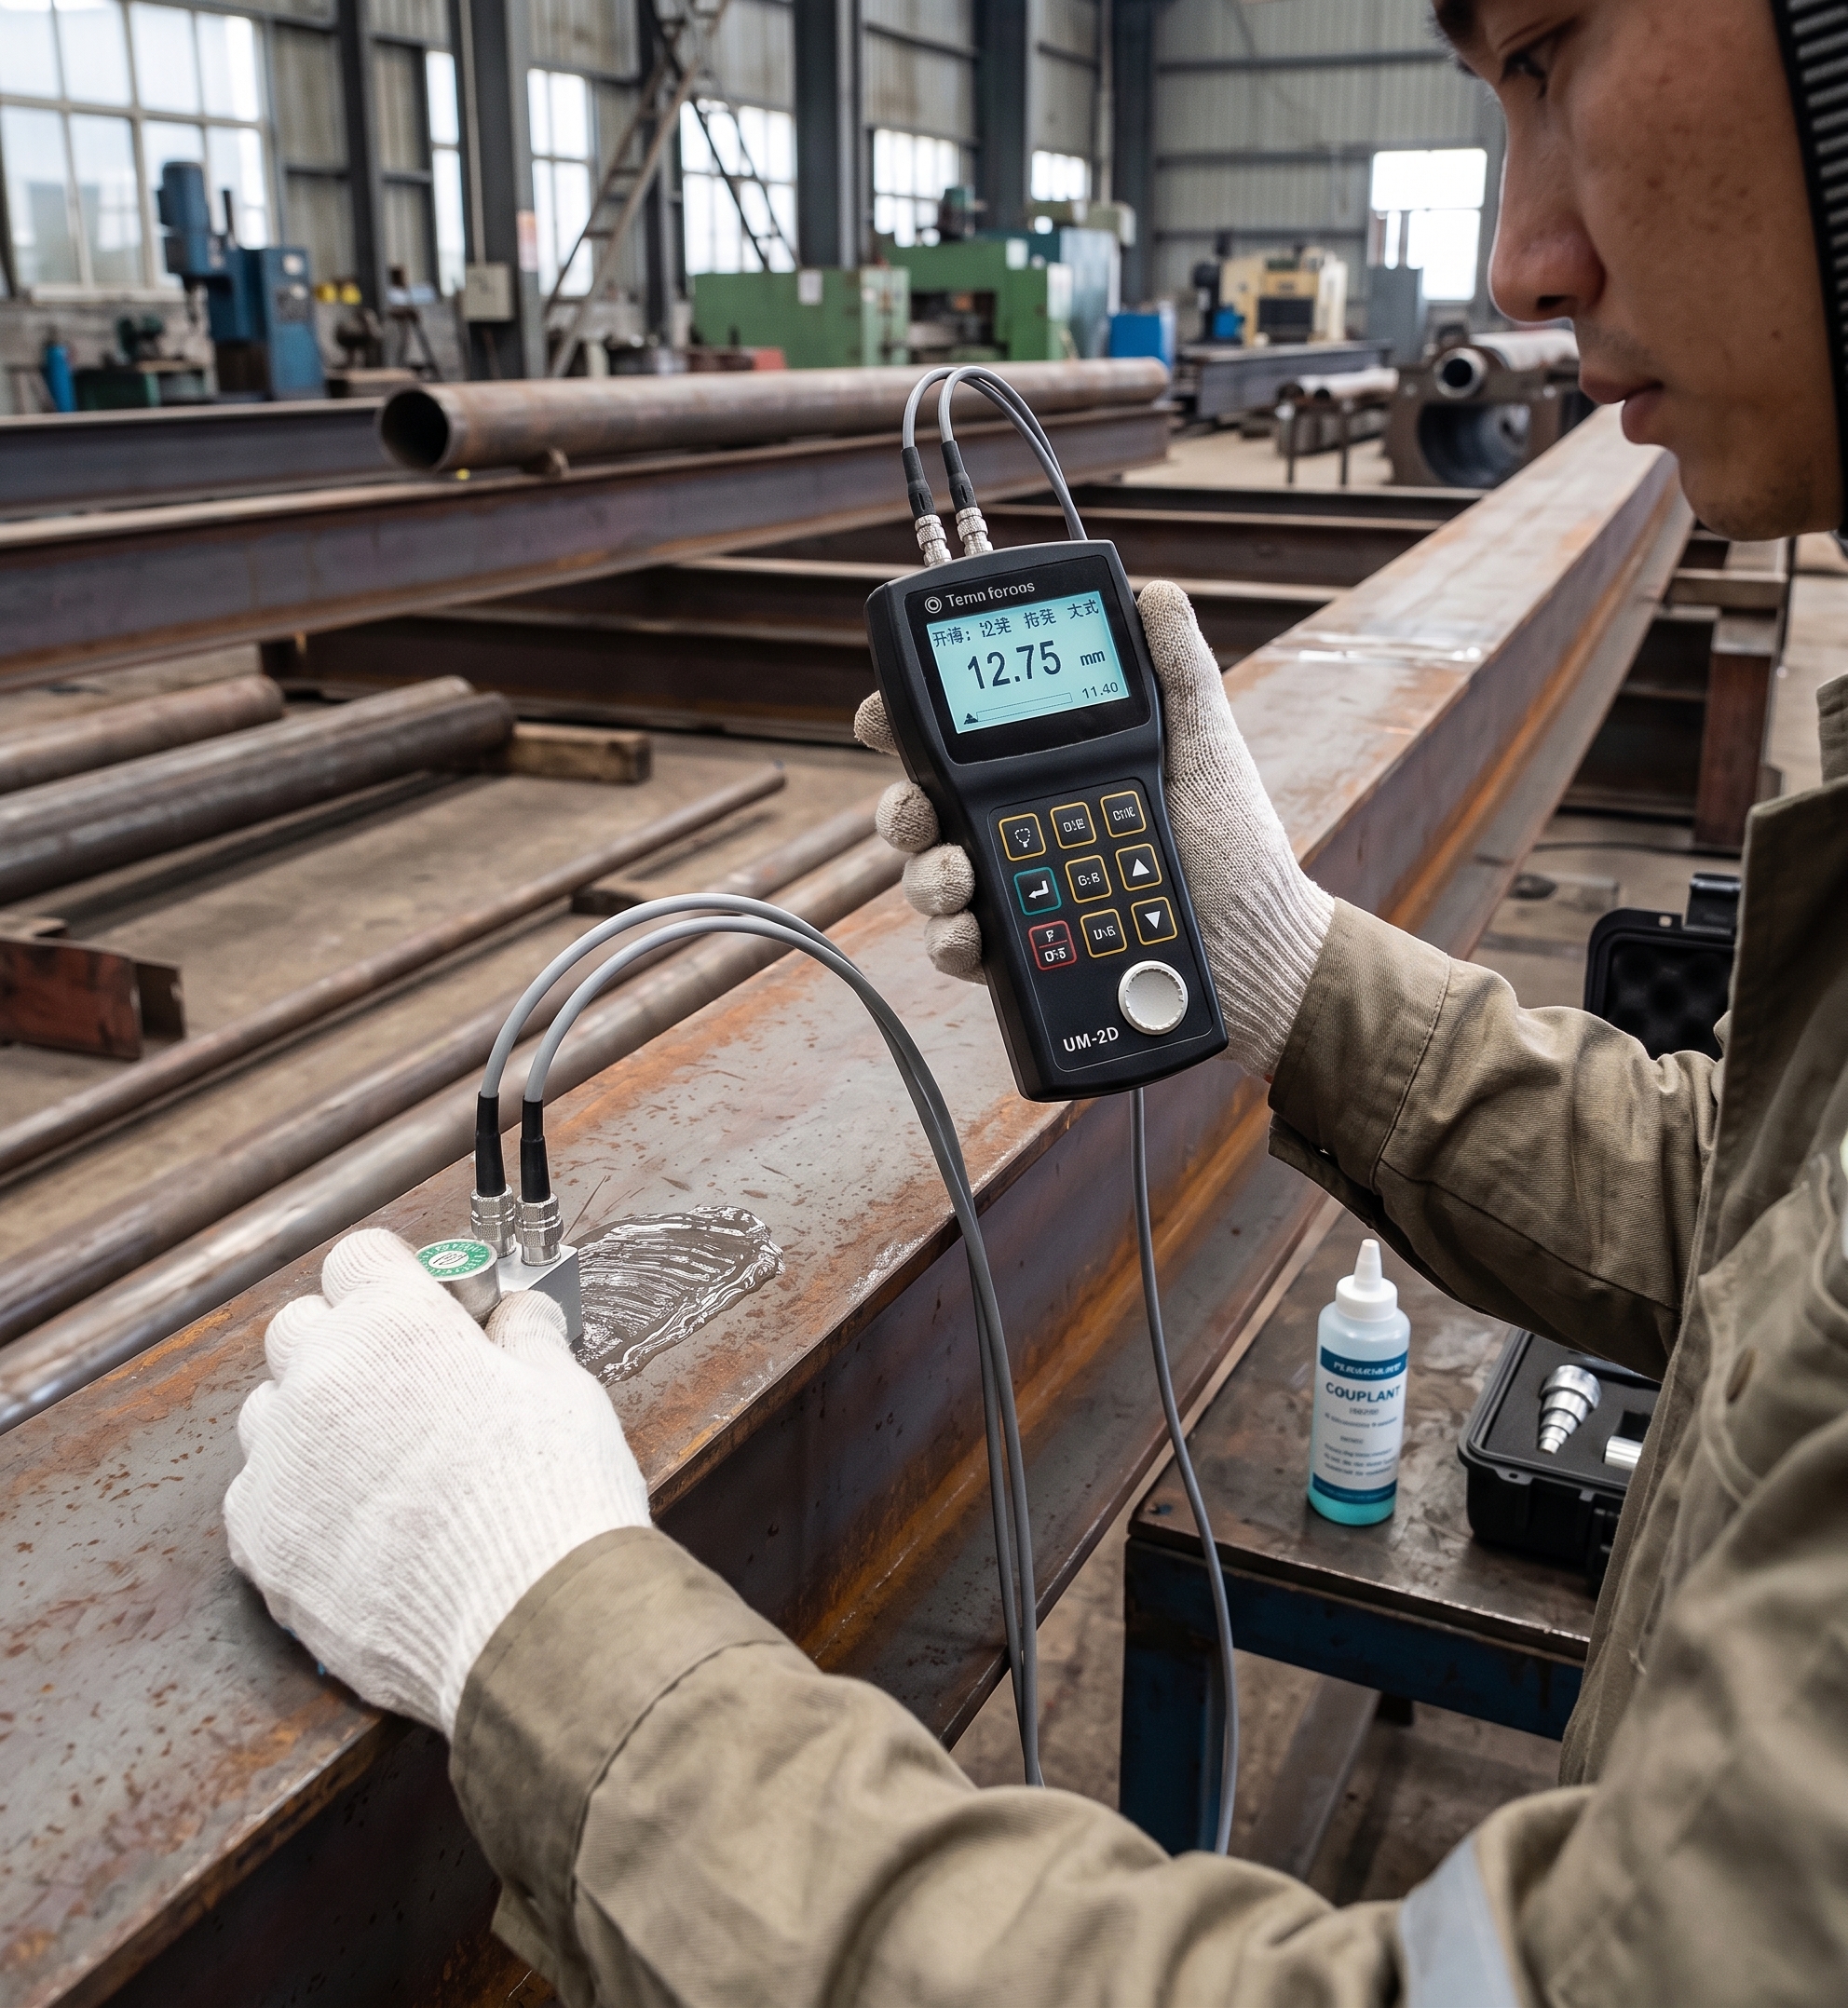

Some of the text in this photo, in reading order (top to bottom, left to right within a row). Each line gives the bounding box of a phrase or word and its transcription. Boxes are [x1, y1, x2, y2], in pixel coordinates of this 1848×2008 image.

[967, 640, 1107, 689] 12.75 mm
[1081, 682, 1119, 699] 11.40
[1063, 1026, 1119, 1052] UM-2D
[1325, 1382, 1401, 1403] COUPLANT
